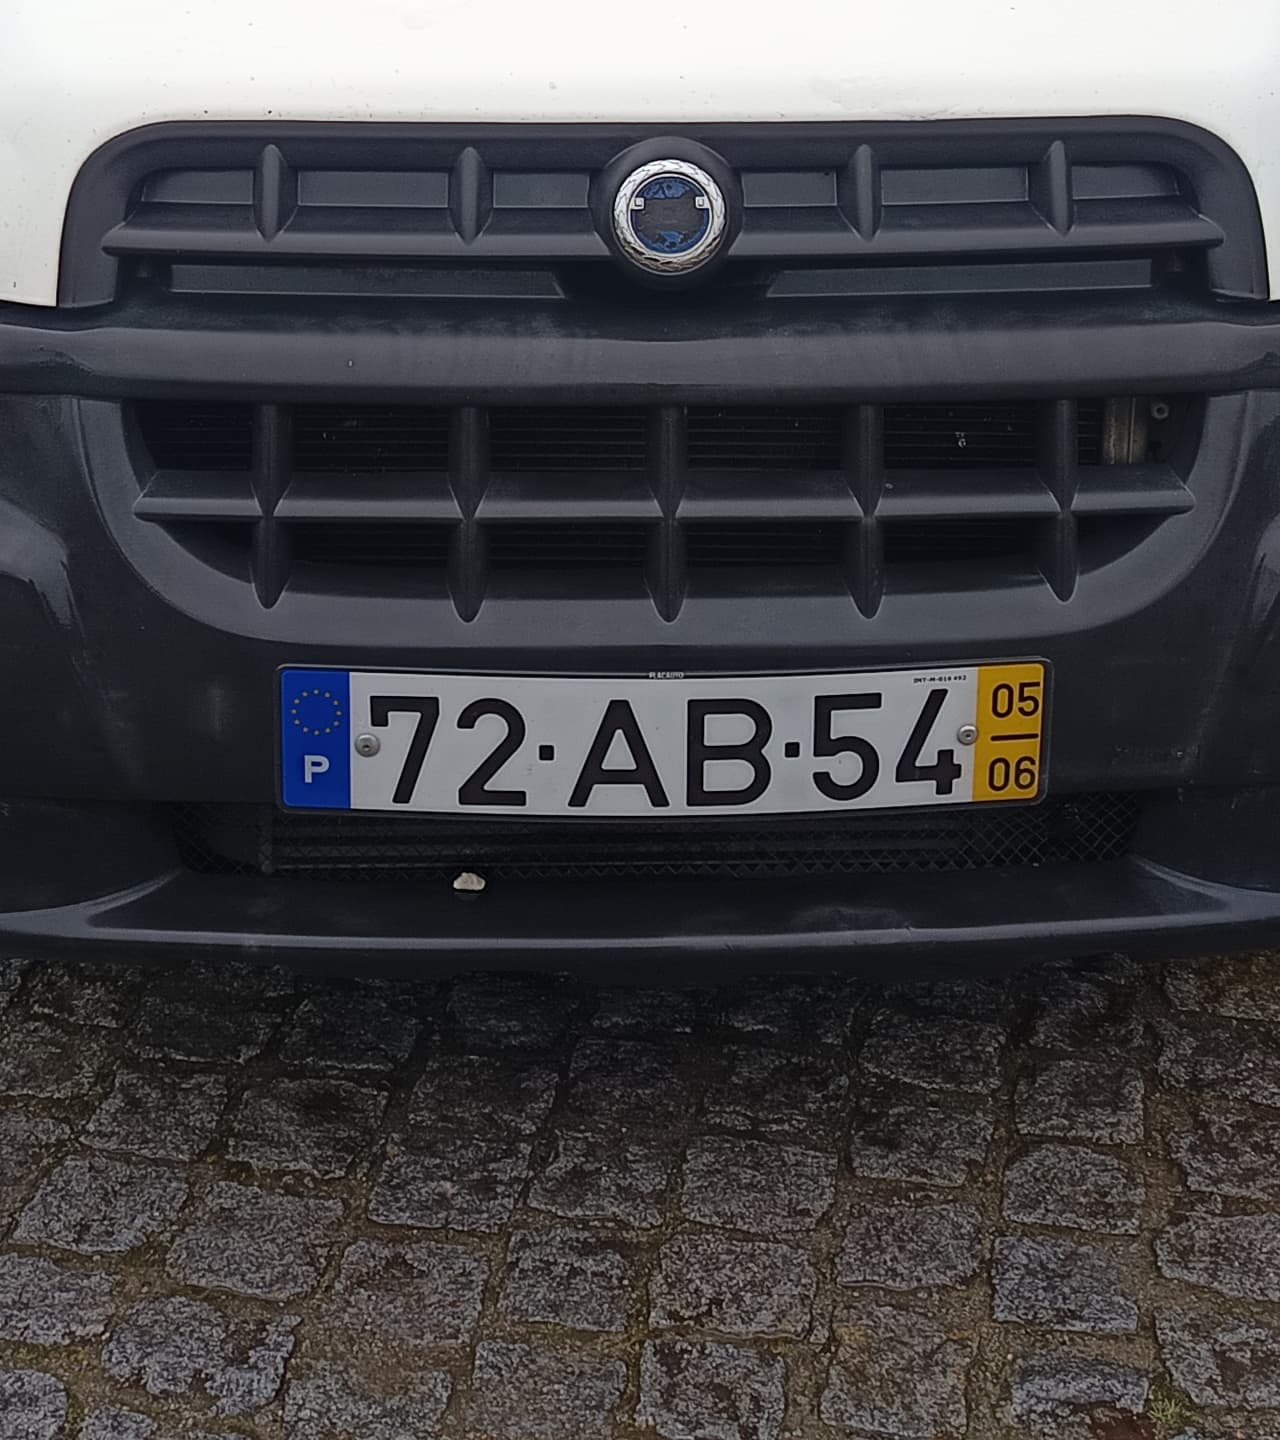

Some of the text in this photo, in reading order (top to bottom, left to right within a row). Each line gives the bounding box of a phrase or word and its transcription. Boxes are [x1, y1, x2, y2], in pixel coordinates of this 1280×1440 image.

[991, 681, 1041, 718] 05
[304, 755, 330, 783] P
[988, 755, 1037, 792] 06
